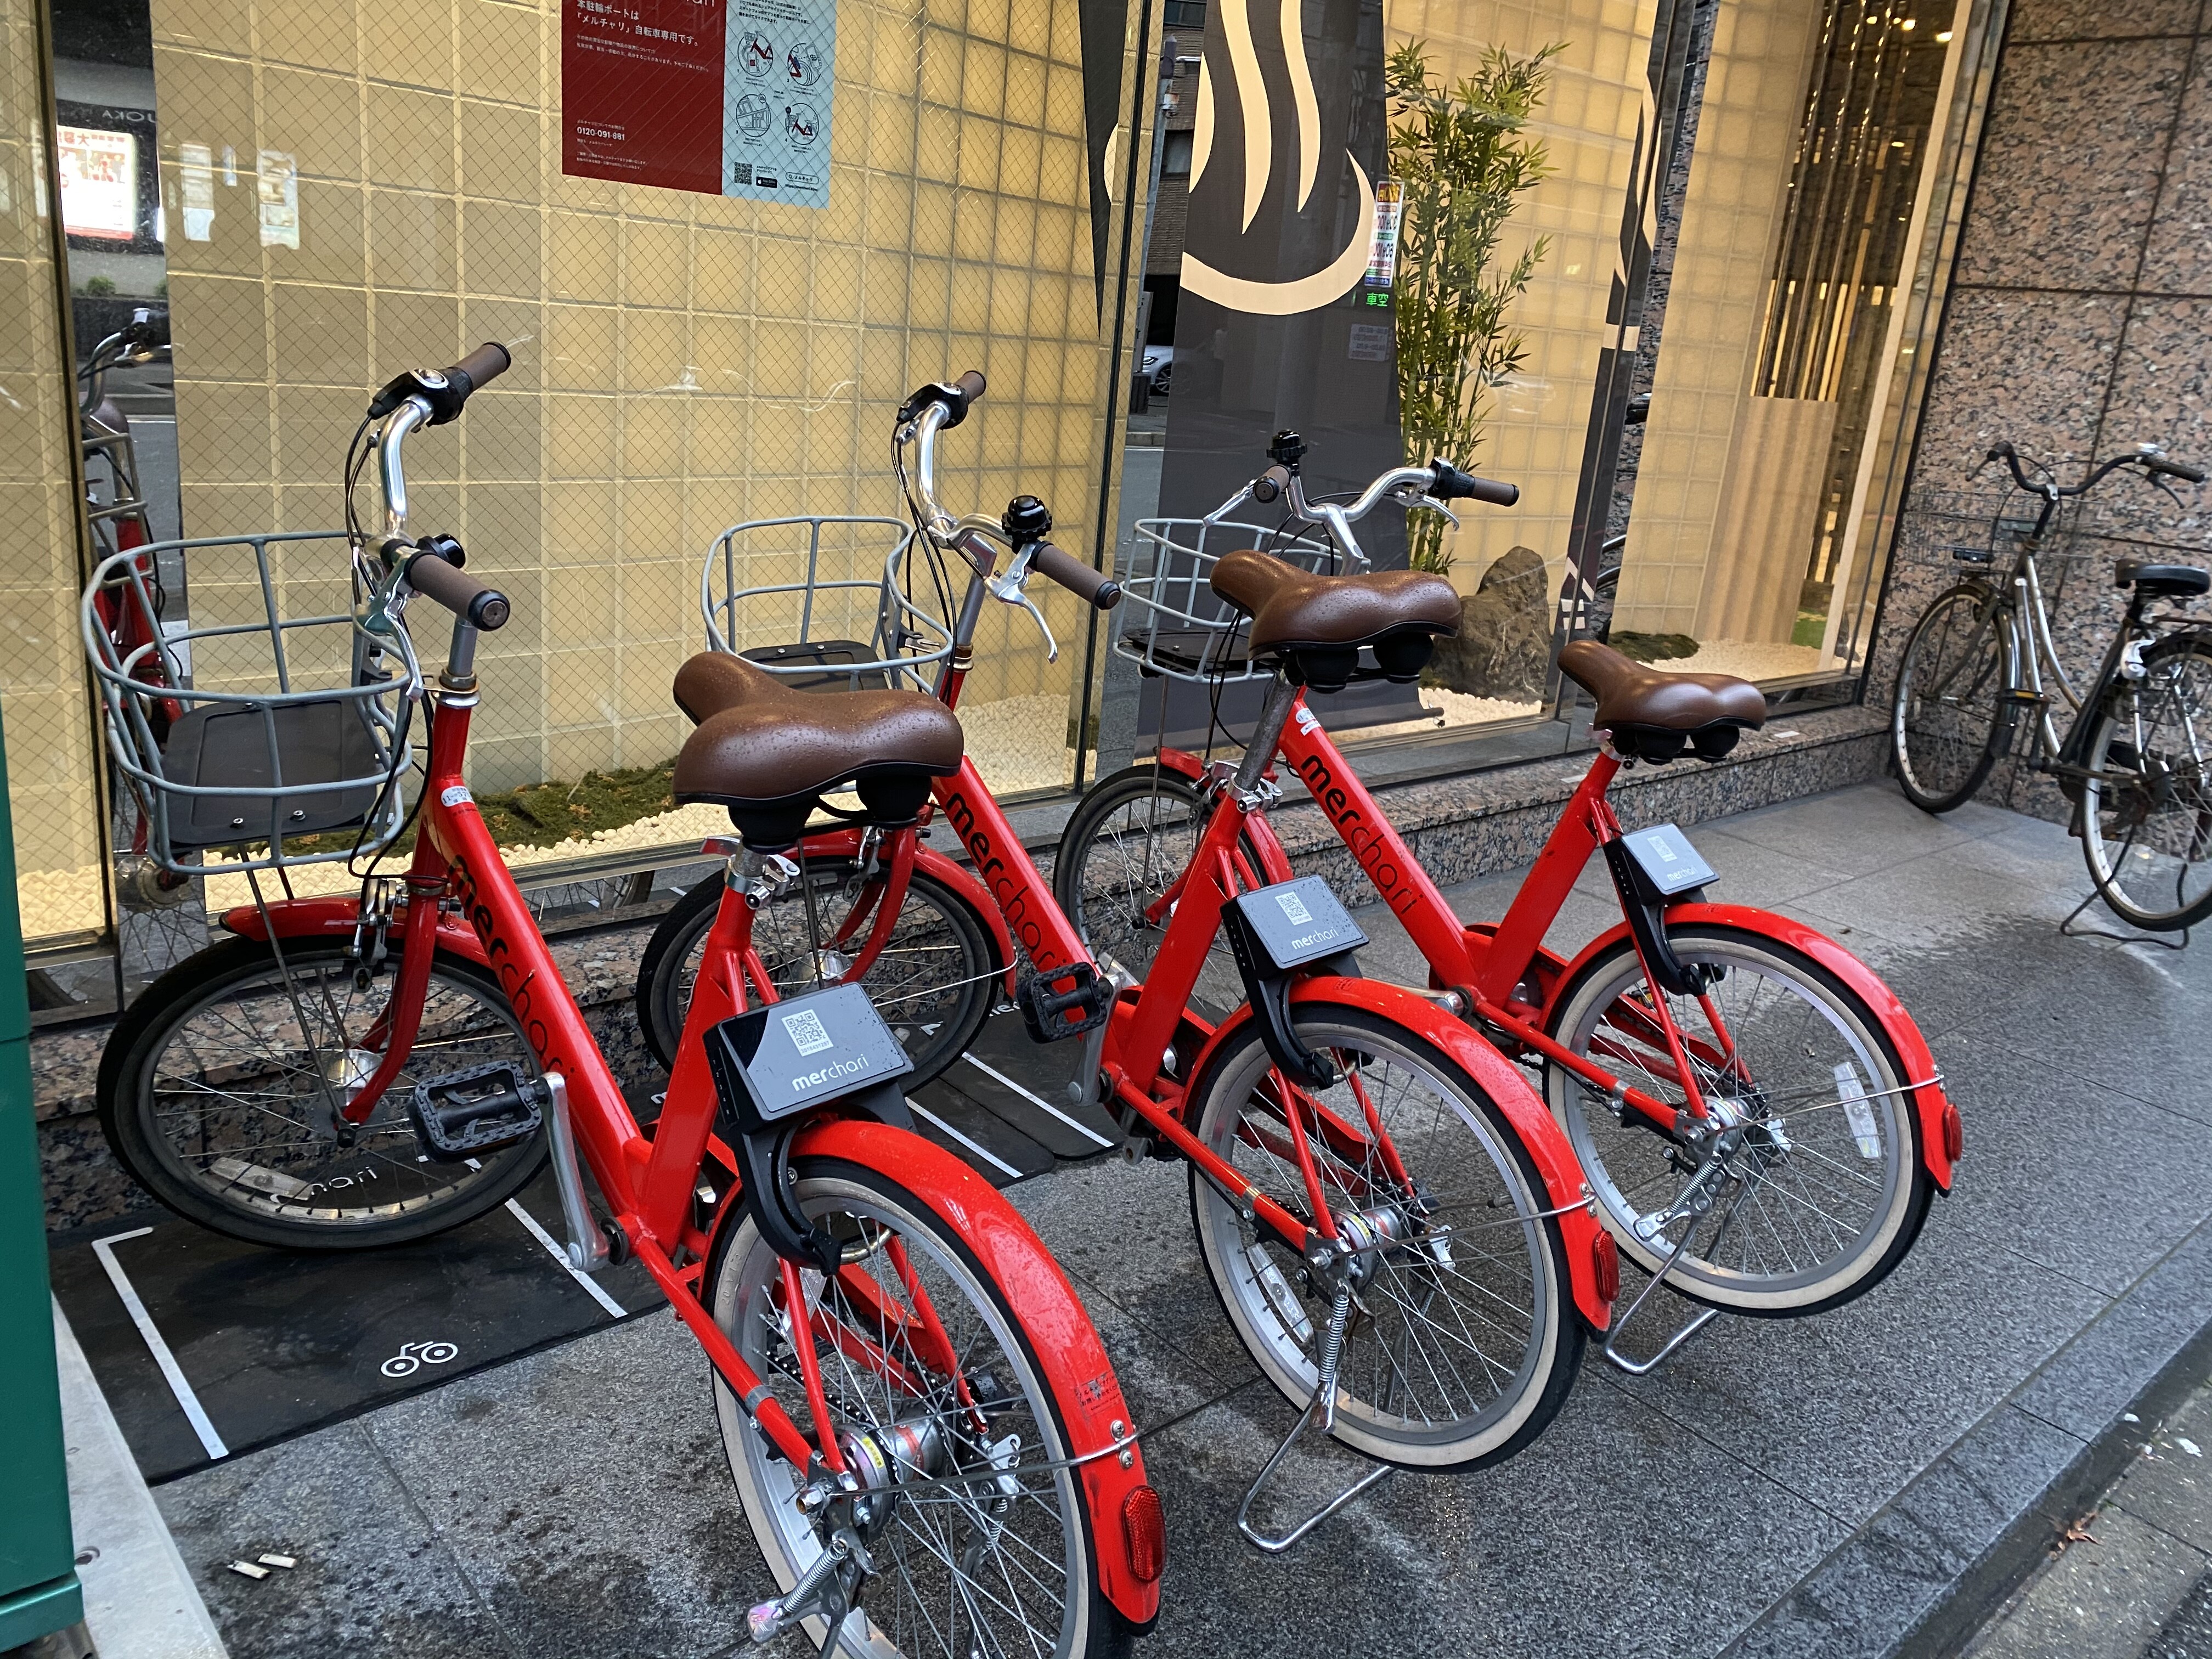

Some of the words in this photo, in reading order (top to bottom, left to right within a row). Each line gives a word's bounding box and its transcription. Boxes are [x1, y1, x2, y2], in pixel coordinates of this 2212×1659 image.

[1300, 754, 1424, 916] merchari
[1291, 926, 1339, 950] merchari
[792, 1053, 869, 1091] merchari
